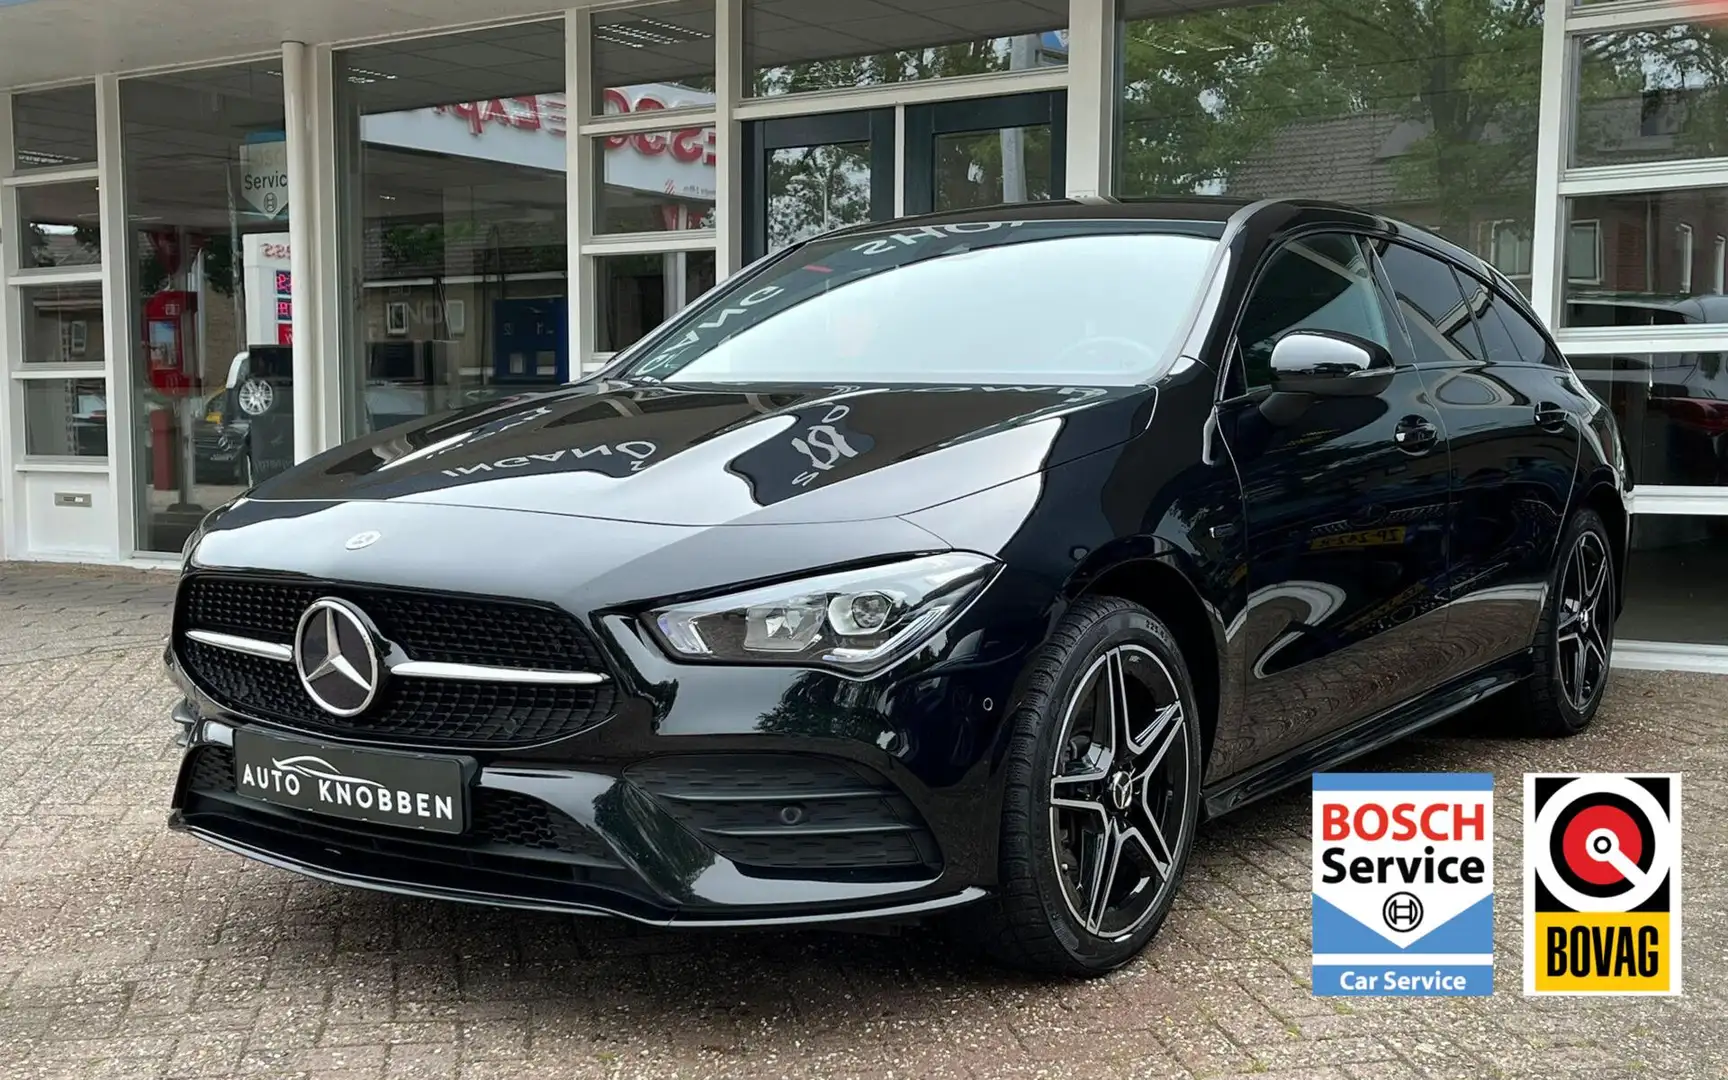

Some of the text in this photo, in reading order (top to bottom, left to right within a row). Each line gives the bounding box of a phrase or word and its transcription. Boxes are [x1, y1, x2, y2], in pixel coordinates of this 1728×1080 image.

[244, 170, 288, 190] Servic
[242, 763, 453, 820] AUTO KNOBBEN
